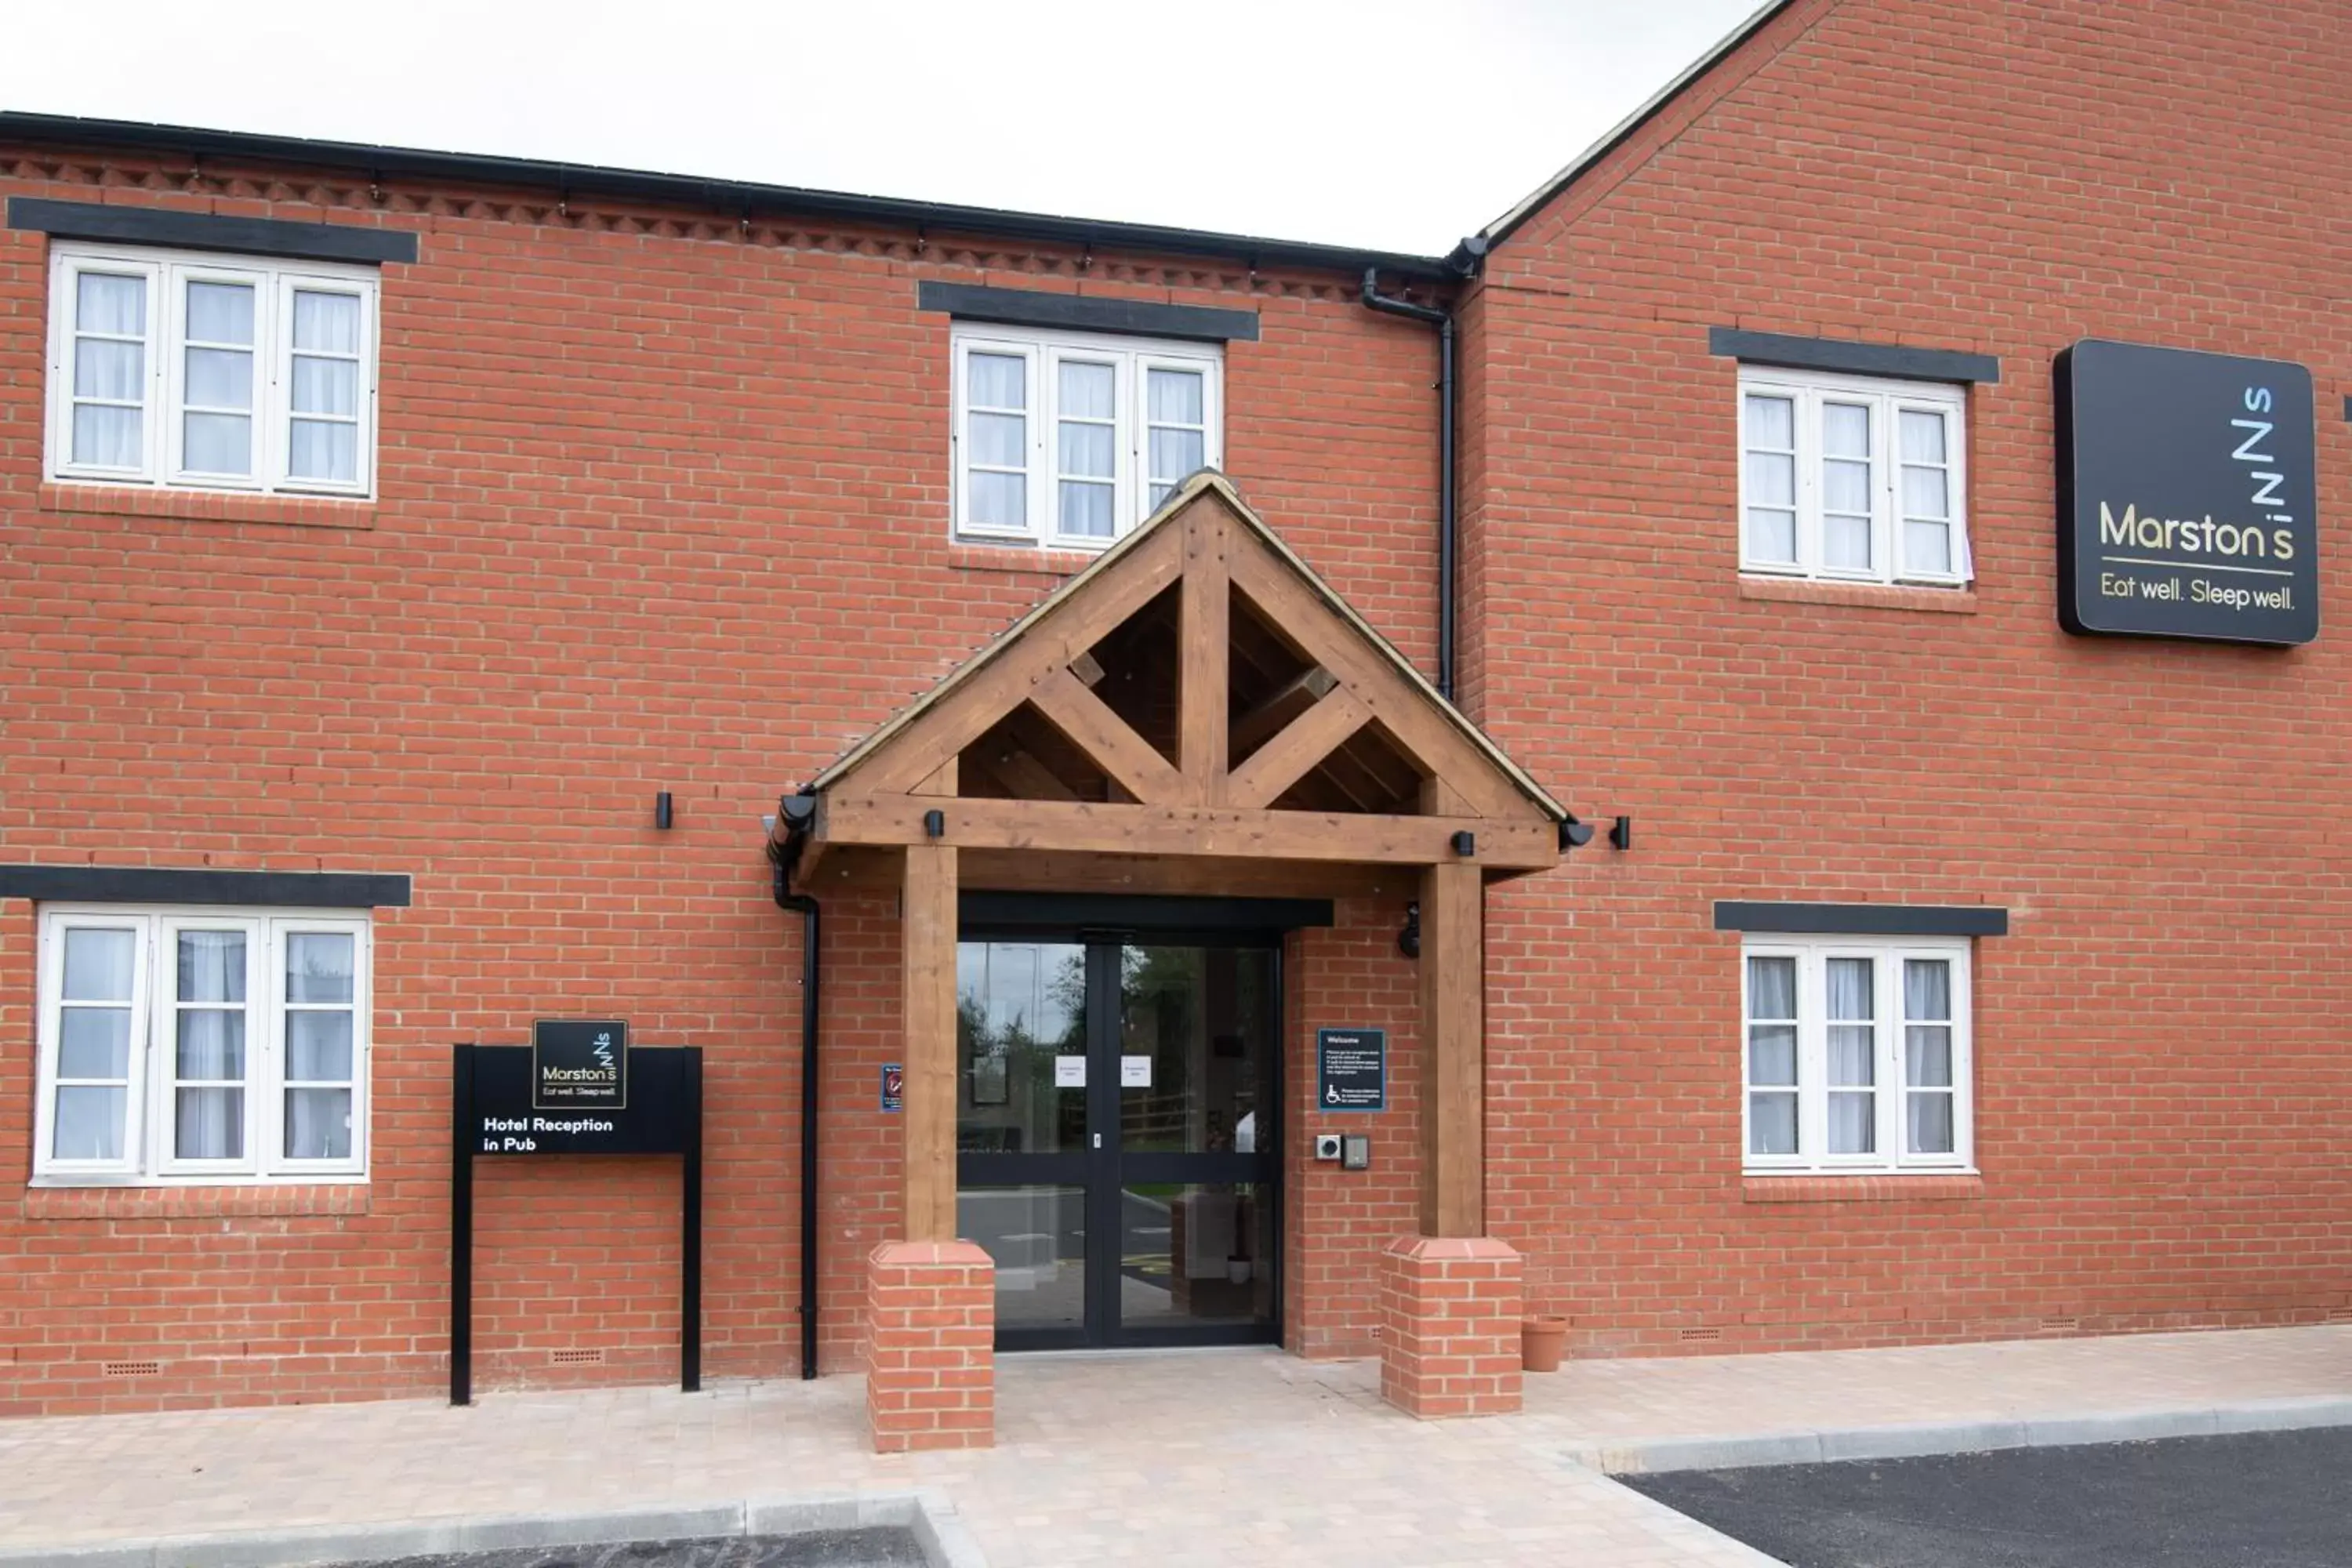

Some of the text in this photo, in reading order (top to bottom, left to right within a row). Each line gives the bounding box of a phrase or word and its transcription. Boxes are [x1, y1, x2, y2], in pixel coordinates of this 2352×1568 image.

[2101, 572, 2296, 612] Eat well. Sleep well.
[484, 1117, 614, 1134] Hotel Reception
[483, 1138, 537, 1151] in Pub
